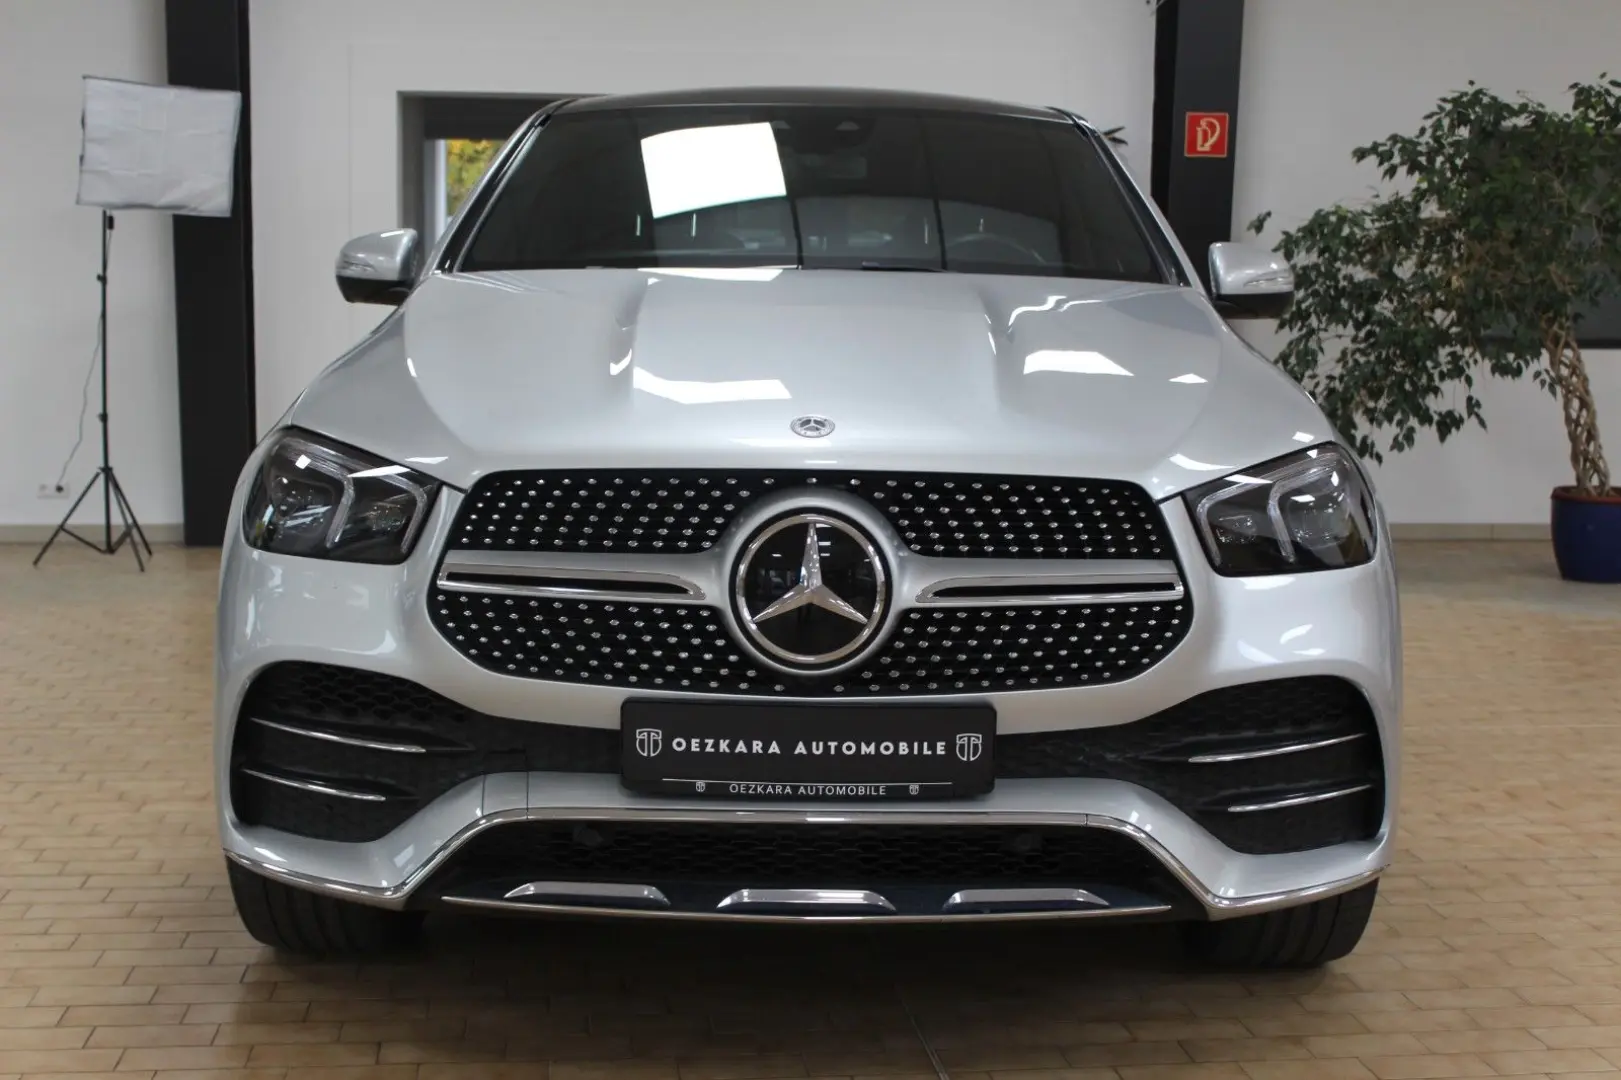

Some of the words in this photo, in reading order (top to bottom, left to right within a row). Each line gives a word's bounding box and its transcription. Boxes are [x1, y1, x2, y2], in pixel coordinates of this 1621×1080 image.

[672, 737, 781, 754] OEZKARA
[794, 740, 946, 755] AUTOMOBILE
[729, 783, 793, 795] OEZKARA
[798, 785, 886, 796] AUTOMOBILE
